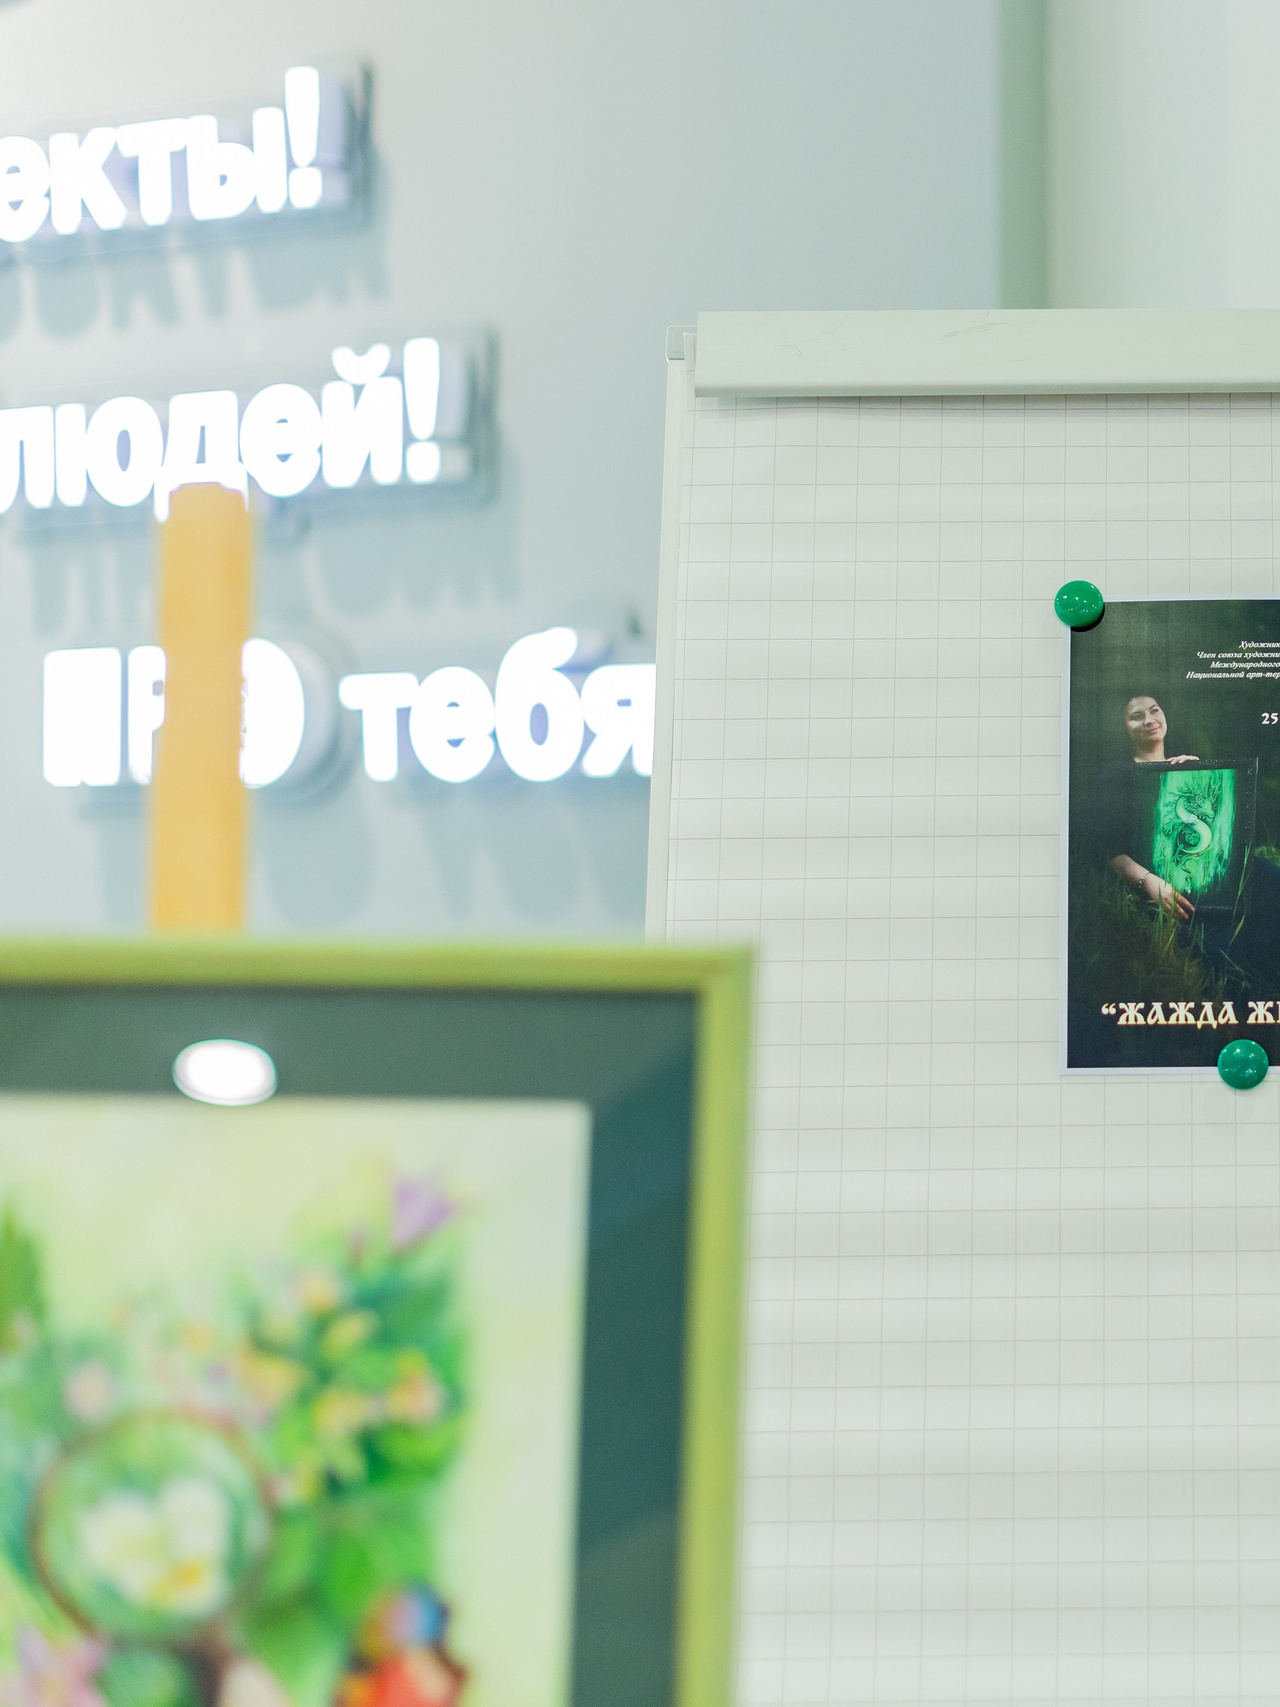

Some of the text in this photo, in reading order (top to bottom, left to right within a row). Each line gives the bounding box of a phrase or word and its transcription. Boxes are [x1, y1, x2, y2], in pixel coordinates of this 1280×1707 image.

[1196, 651, 1216, 659] Член
[1210, 661, 1280, 670] Международного
[1186, 671, 1245, 680] Национальной
[338, 626, 657, 784] тебя
[1261, 712, 1279, 725] 25
